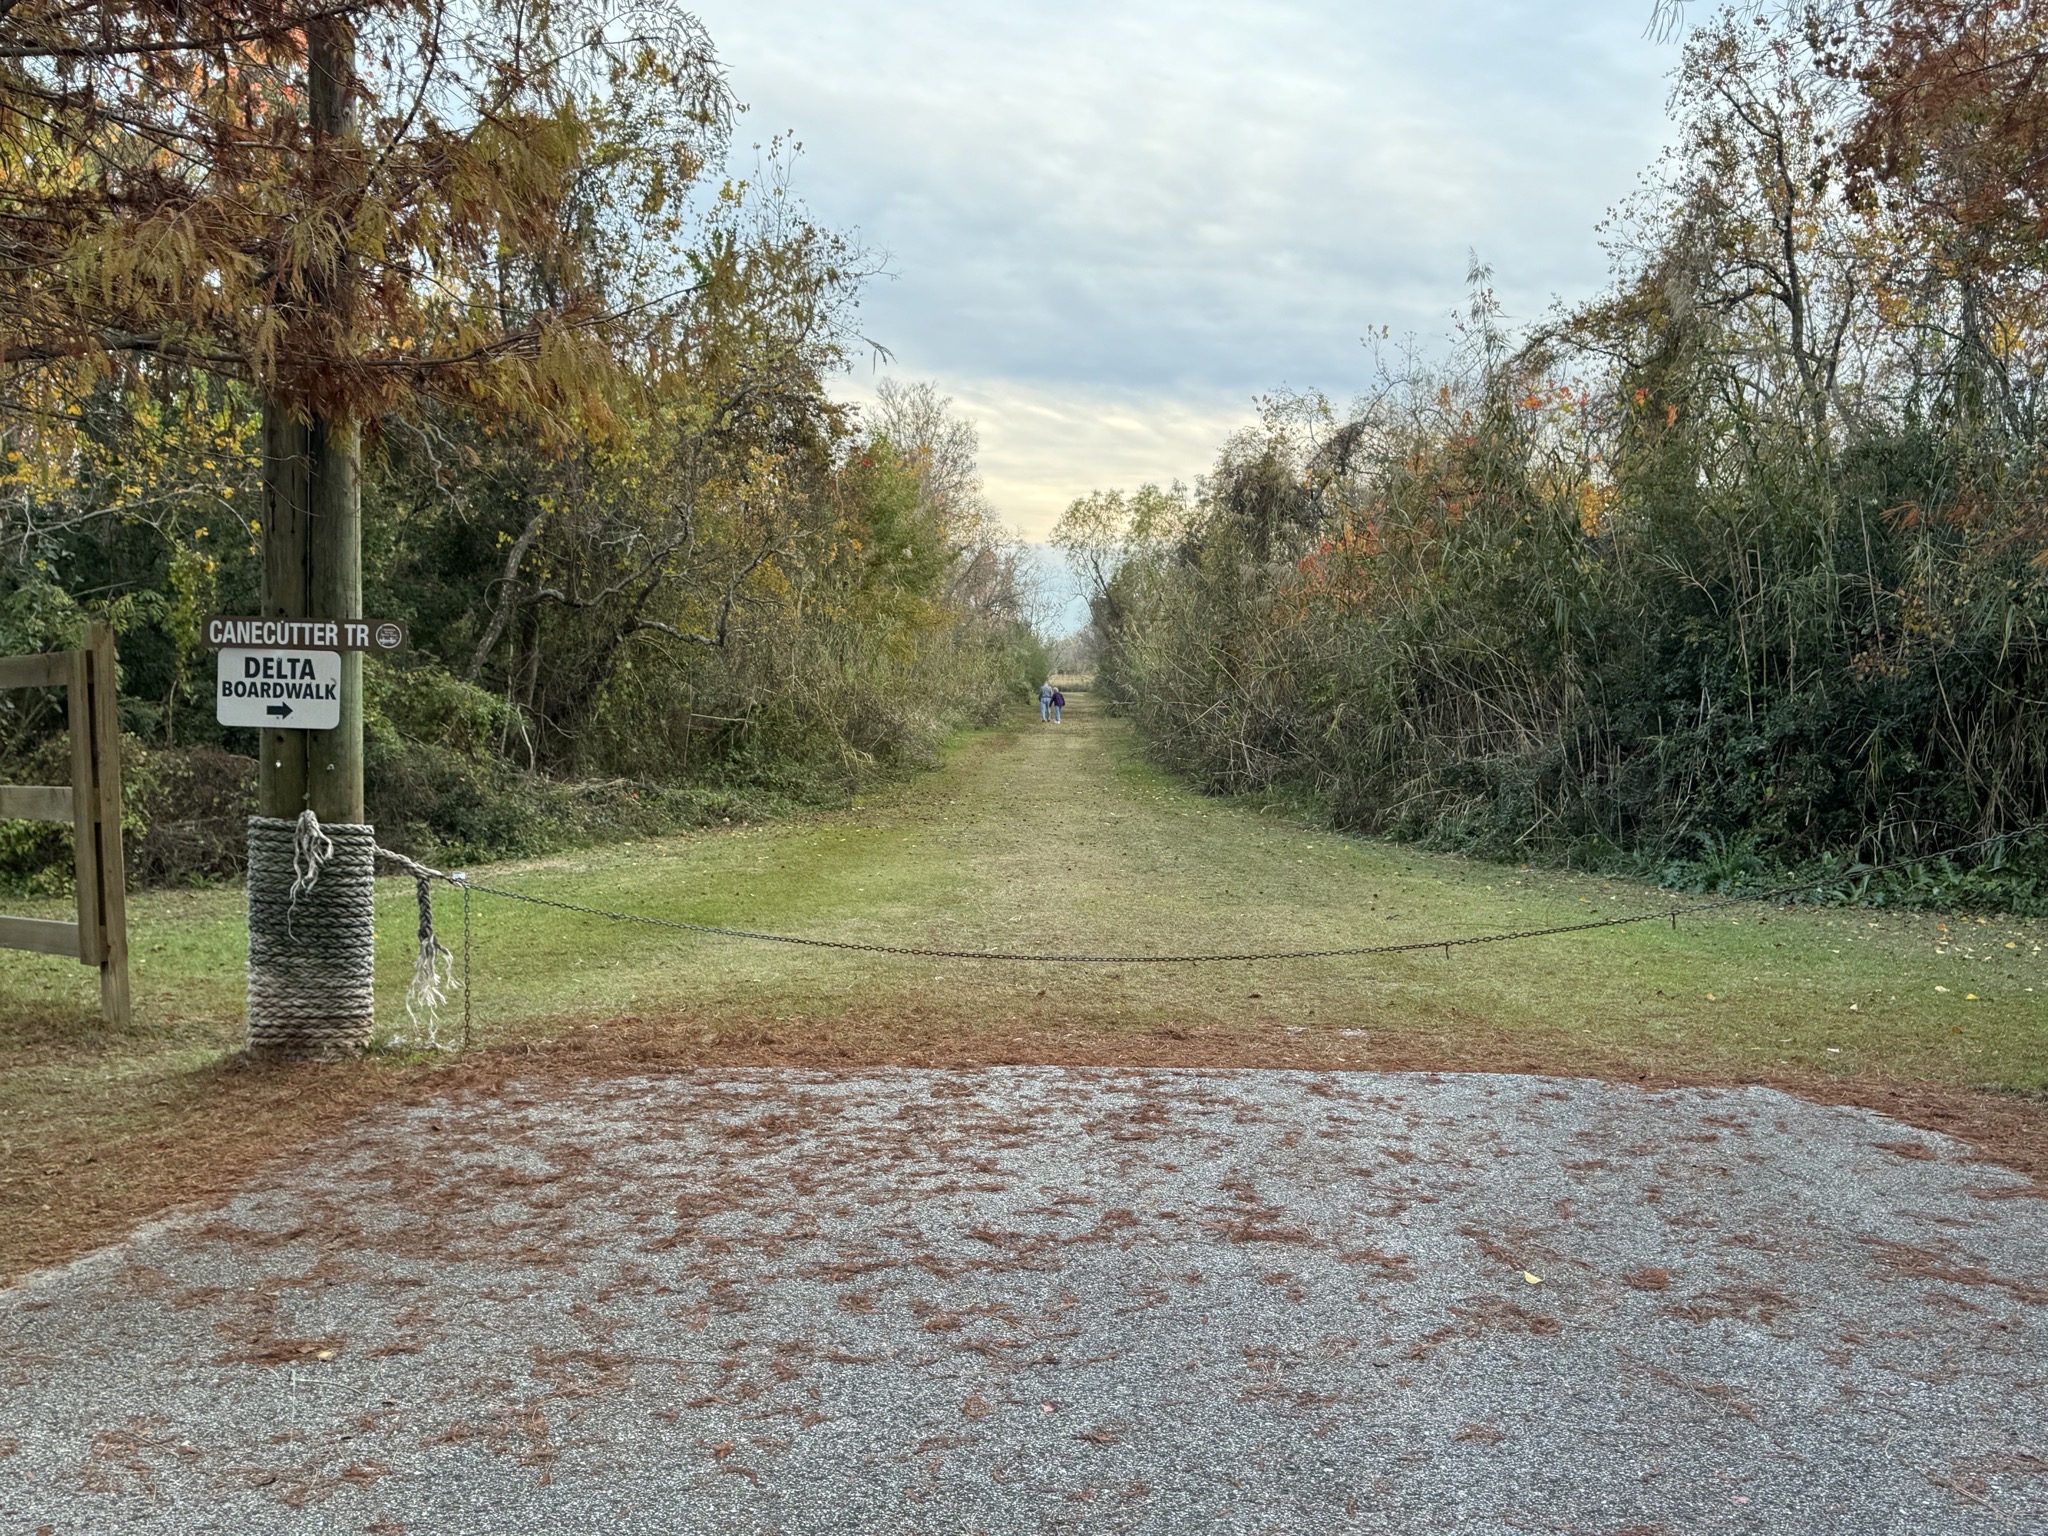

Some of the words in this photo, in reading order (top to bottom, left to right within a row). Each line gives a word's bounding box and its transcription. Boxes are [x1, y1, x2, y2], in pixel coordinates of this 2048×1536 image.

[209, 620, 338, 646] CANECUTTER
[344, 624, 369, 647] TR
[244, 657, 316, 680] DELTA
[222, 681, 336, 700] BOARDWALK
